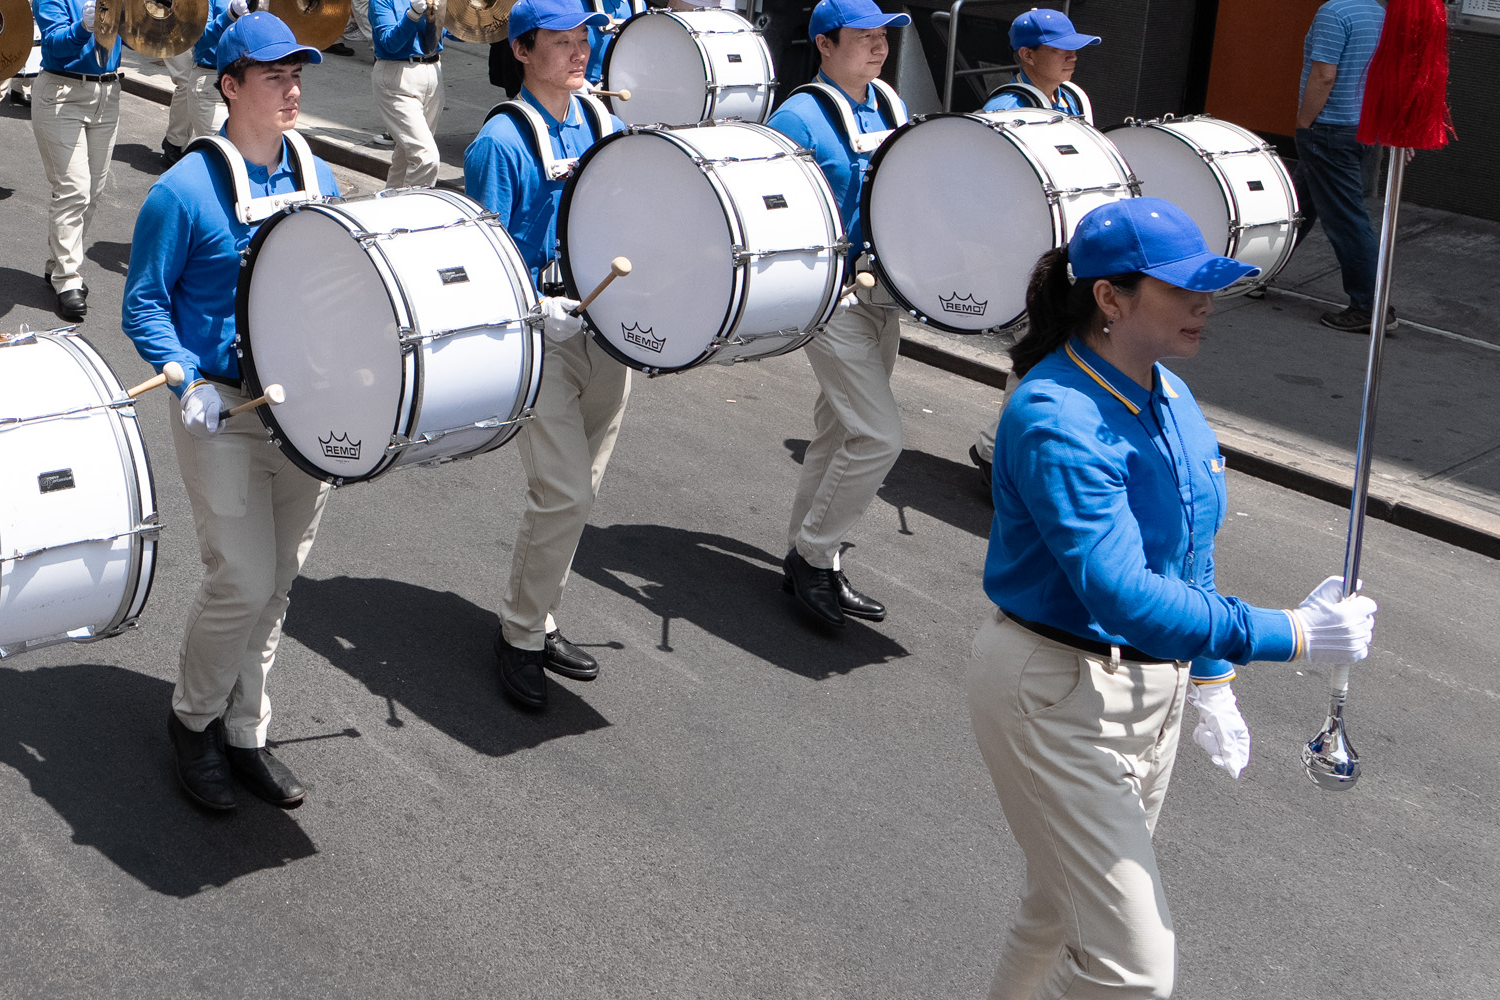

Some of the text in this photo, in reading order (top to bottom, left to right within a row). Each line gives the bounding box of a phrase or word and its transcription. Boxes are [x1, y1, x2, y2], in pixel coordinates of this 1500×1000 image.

[943, 302, 985, 315] REMO
[624, 331, 663, 352] REMO
[325, 443, 357, 457] REMO
